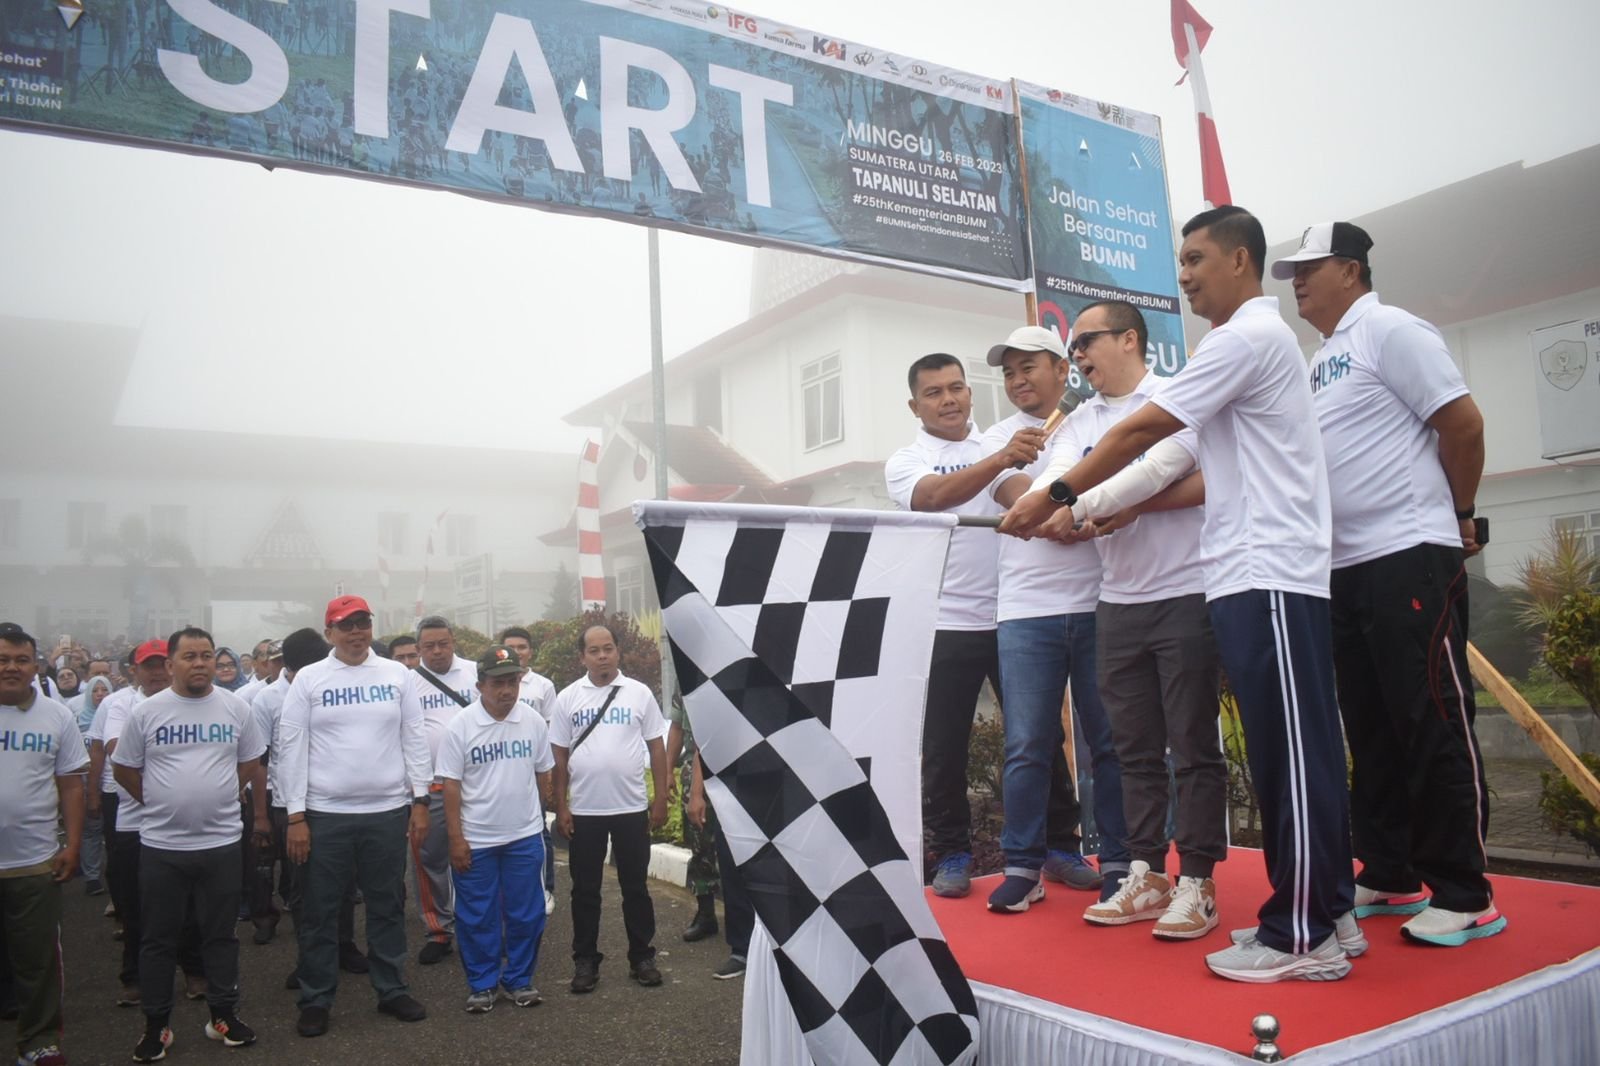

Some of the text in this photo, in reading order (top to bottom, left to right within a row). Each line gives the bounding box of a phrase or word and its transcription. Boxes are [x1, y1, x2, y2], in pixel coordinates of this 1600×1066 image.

[813, 35, 847, 61] KAI
[9, 77, 63, 95] Thohir
[15, 93, 62, 110] BUMN
[157, 0, 793, 208] START
[847, 119, 933, 156] MINGGU
[850, 147, 958, 182] SUMATERA UTARA
[939, 150, 1003, 174] 26 FEB 2023
[852, 167, 997, 213] TAPANULI SELATAN
[852, 194, 987, 228] #25thKementerianBUMN
[1048, 185, 1158, 229] Jalan Sehat
[1064, 213, 1147, 249] Bersama
[1080, 242, 1136, 271] BUMN
[1046, 276, 1172, 310] #25thKementerianBUMN
[322, 684, 394, 707] AKHLAK
[156, 723, 233, 746] AKHLAK
[471, 740, 533, 765] AKHLAK
